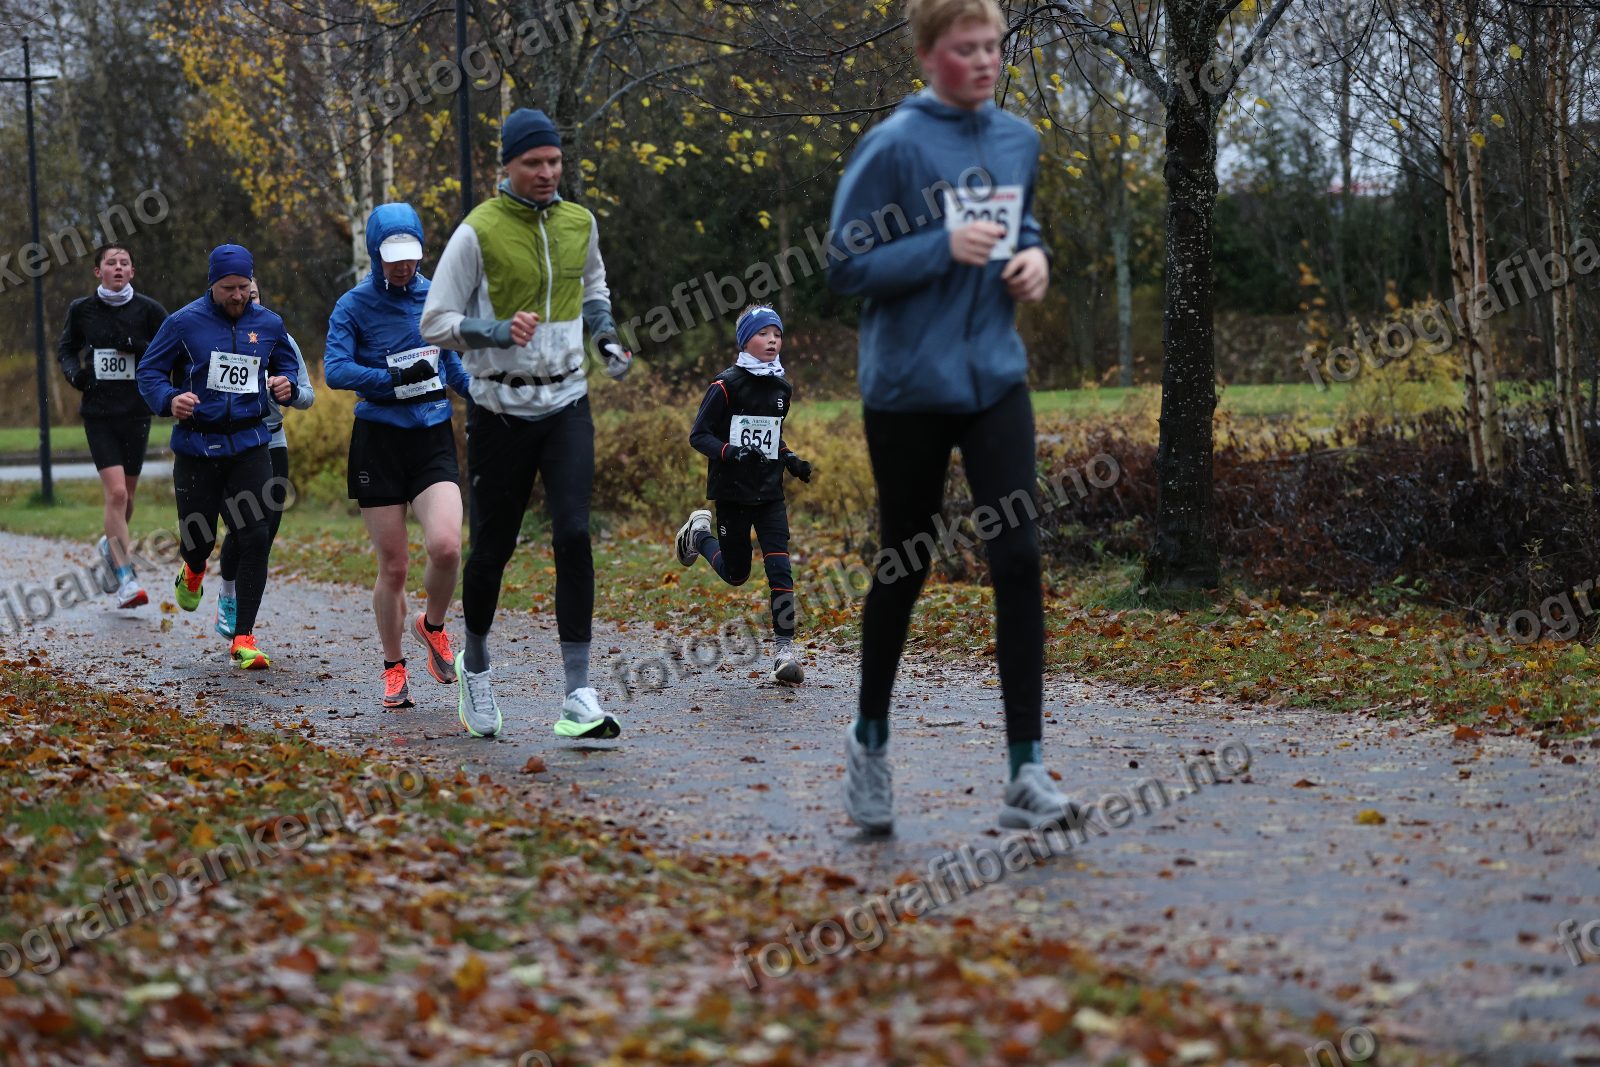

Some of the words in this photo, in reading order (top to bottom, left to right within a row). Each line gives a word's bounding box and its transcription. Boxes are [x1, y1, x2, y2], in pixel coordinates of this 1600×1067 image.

[101, 357, 126, 372] 380
[220, 364, 249, 386] 769
[741, 428, 772, 450] 654
